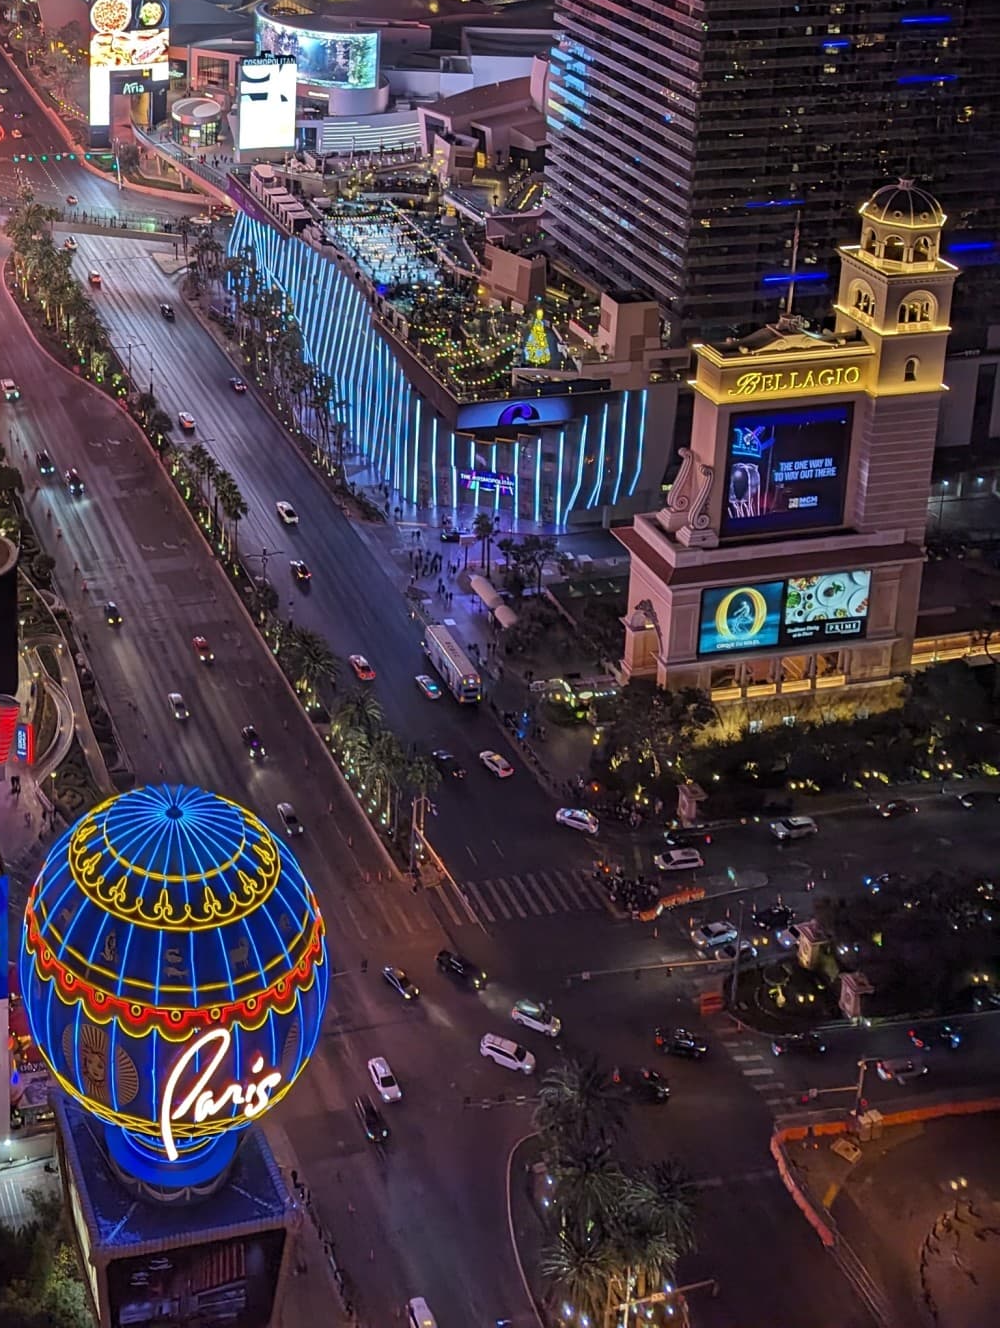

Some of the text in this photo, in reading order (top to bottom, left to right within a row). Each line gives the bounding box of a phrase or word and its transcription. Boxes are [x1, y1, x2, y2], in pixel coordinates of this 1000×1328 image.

[243, 57, 296, 66] COSMOPOLITAN
[122, 82, 145, 95] Aria
[727, 366, 861, 396] BELLAGIO
[779, 461, 794, 472] THE
[794, 460, 809, 470] ONE
[809, 458, 825, 469] WAY
[774, 466, 837, 482] TO WAY OUT THERE
[829, 622, 857, 632] PRIME
[160, 1028, 282, 1162] Paris
